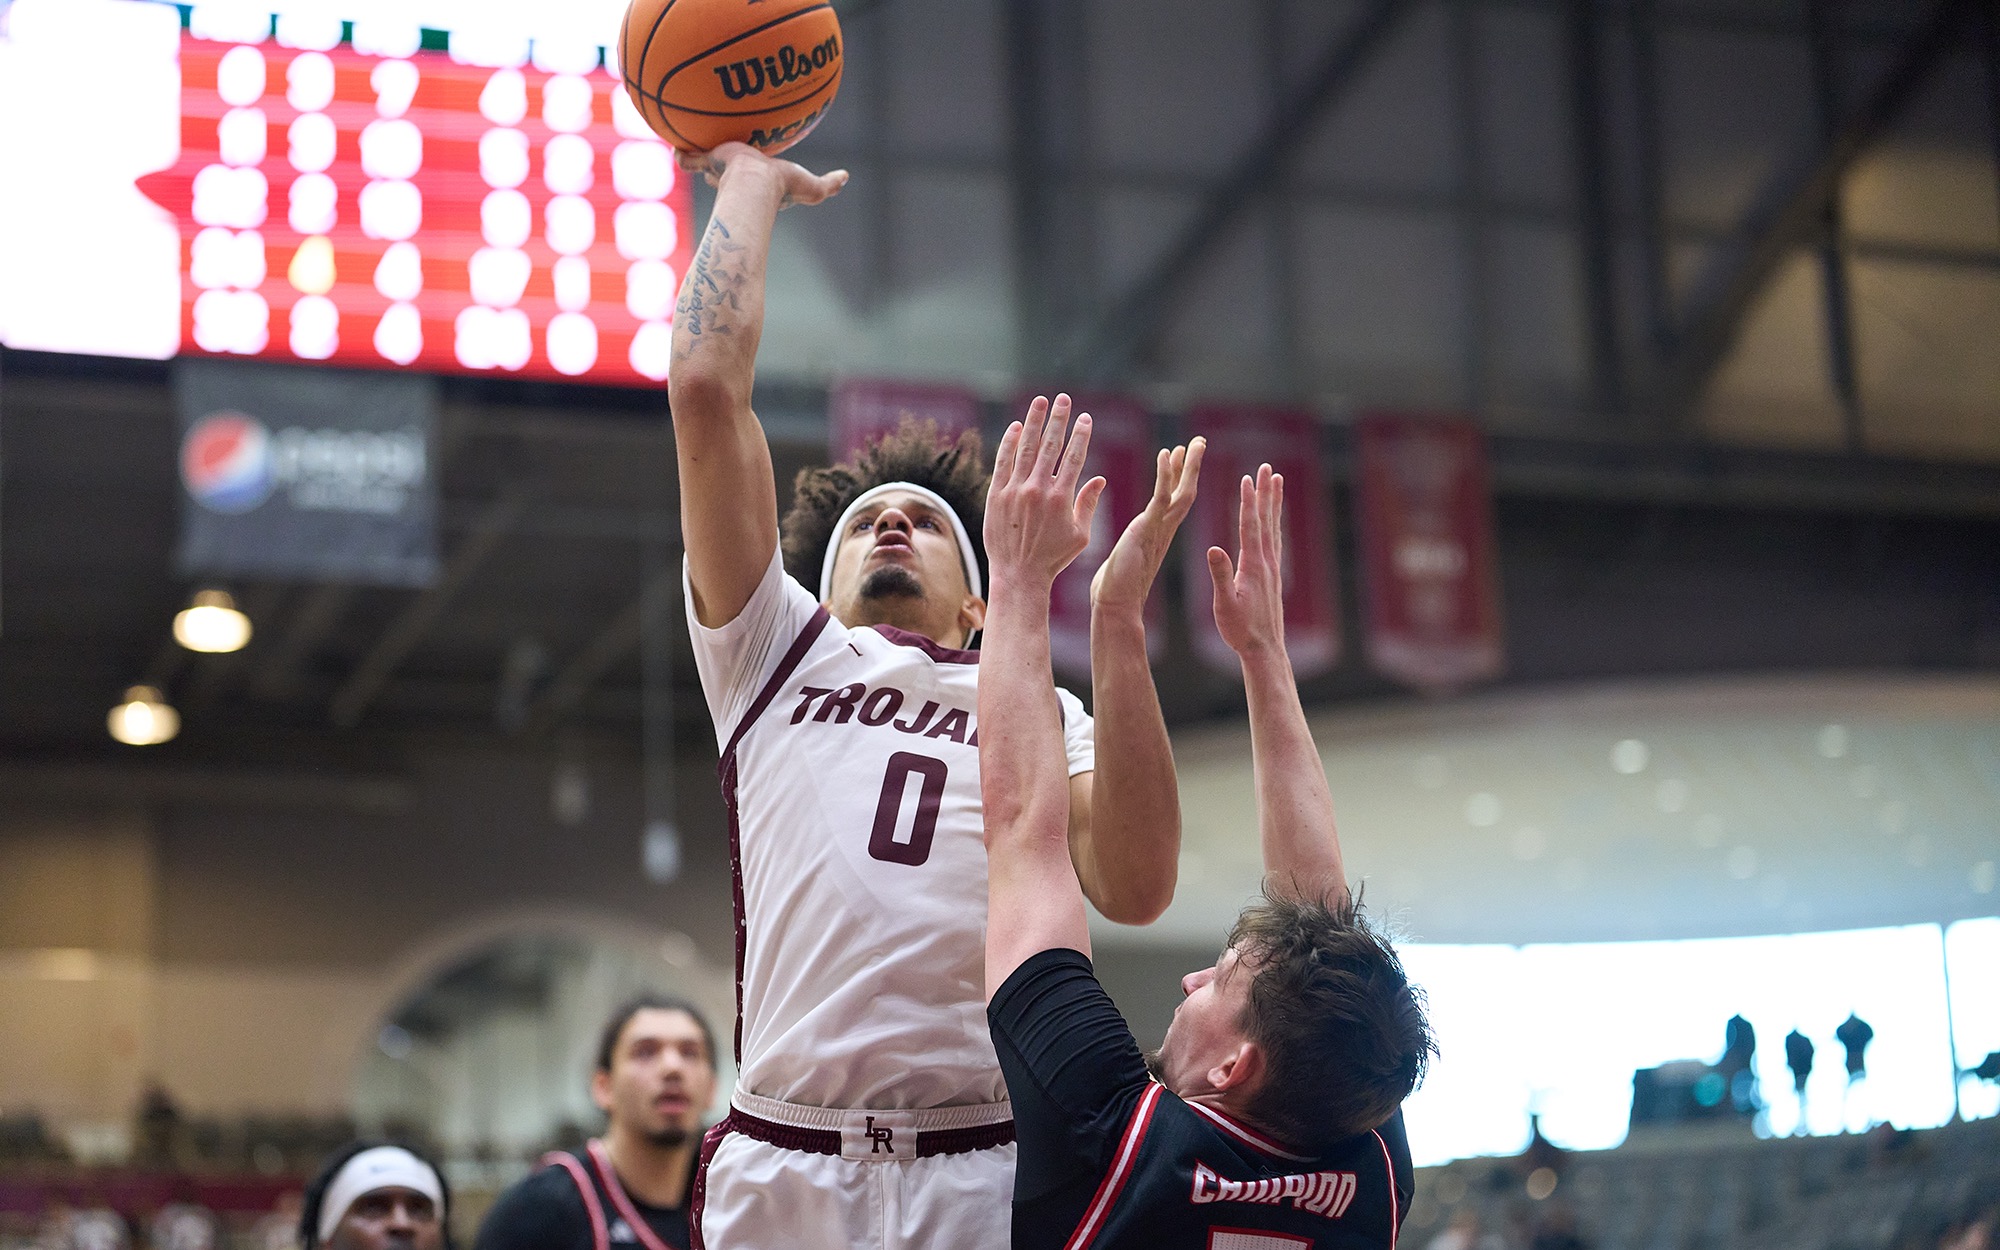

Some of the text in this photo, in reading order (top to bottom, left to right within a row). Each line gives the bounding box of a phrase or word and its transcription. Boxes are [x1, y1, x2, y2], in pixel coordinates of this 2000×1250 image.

[713, 34, 840, 100] Wilson
[789, 682, 980, 748] TROJA
[867, 751, 949, 867] 0
[865, 1116, 895, 1154] LR
